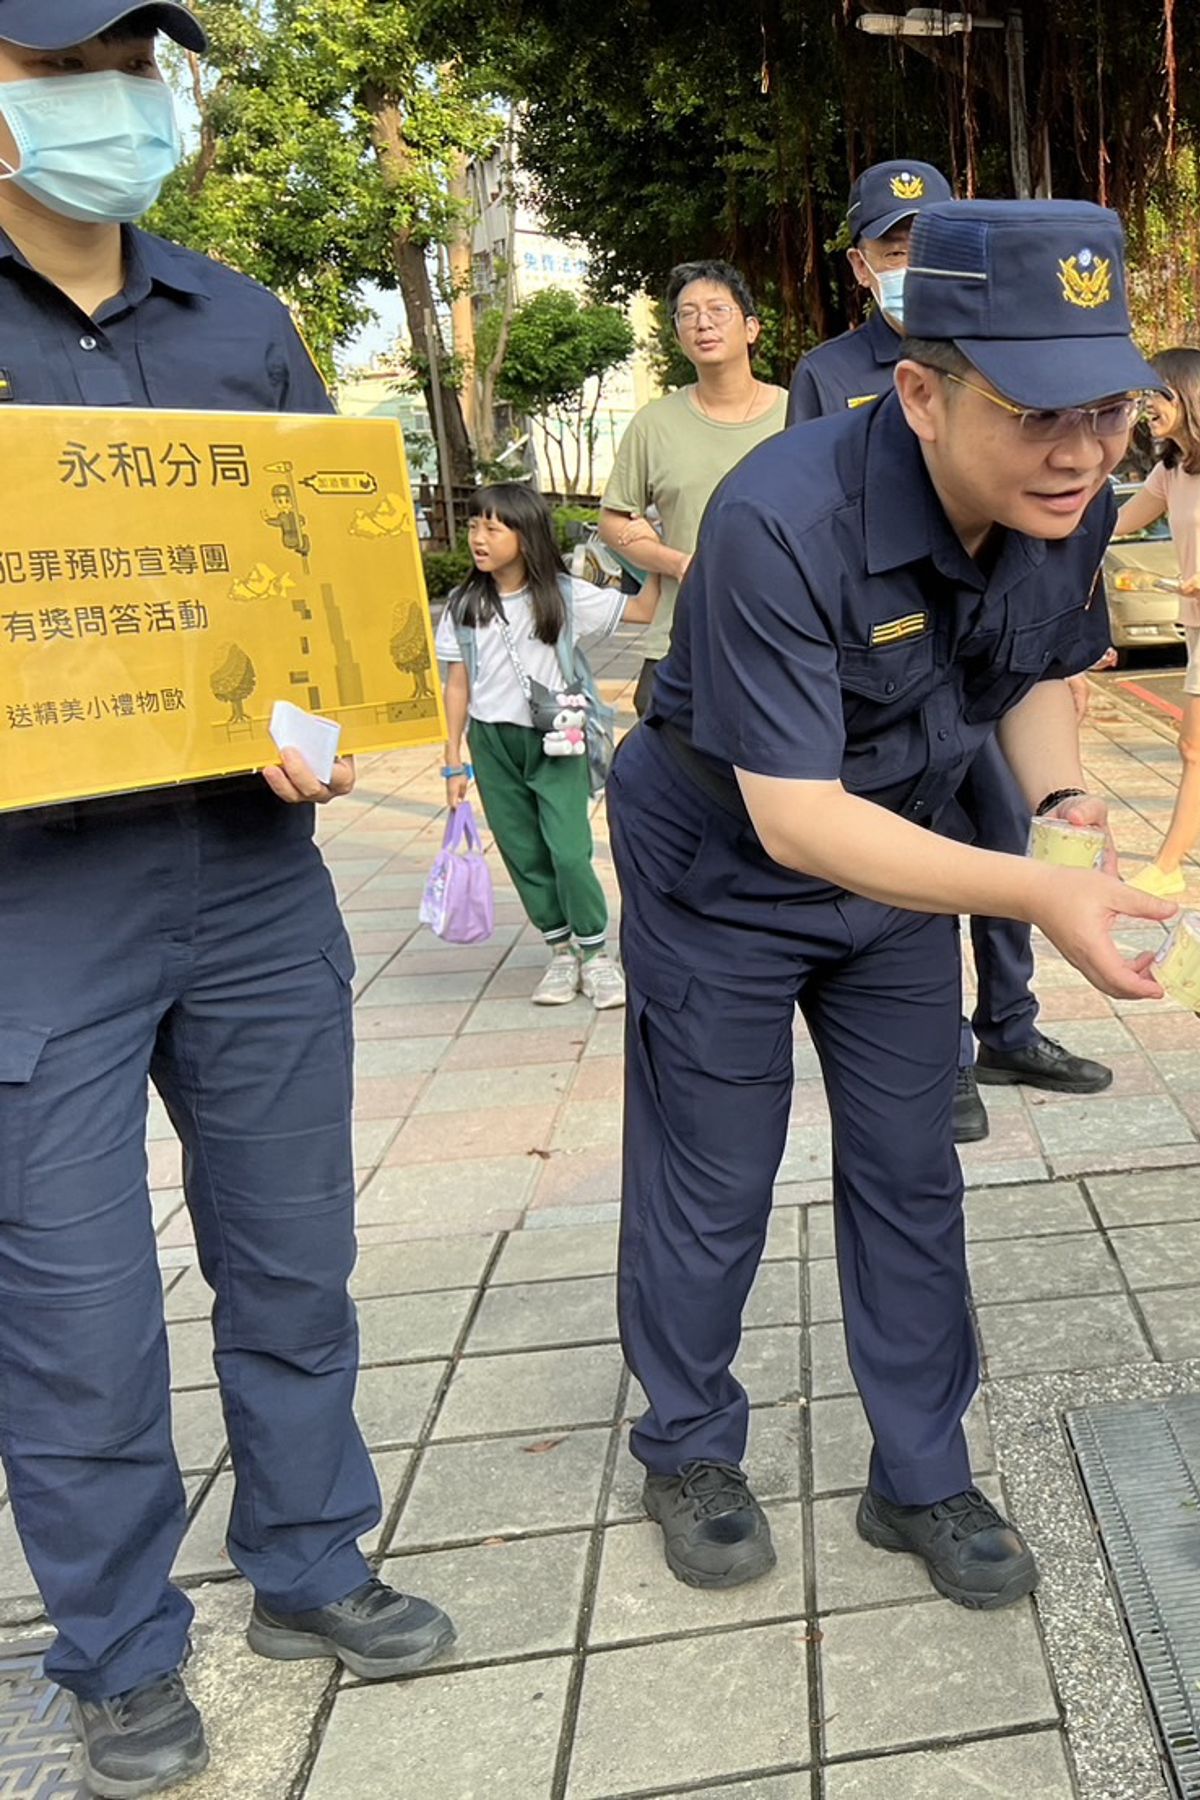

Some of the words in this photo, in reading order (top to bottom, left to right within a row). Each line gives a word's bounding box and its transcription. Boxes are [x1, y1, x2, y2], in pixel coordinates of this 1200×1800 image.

[58, 441, 250, 488] 永和分局
[0, 544, 229, 585] 犯罪預防宣導團
[1, 600, 208, 643] 有獎問答活動
[6, 688, 186, 729] 送精美小禮物歐
